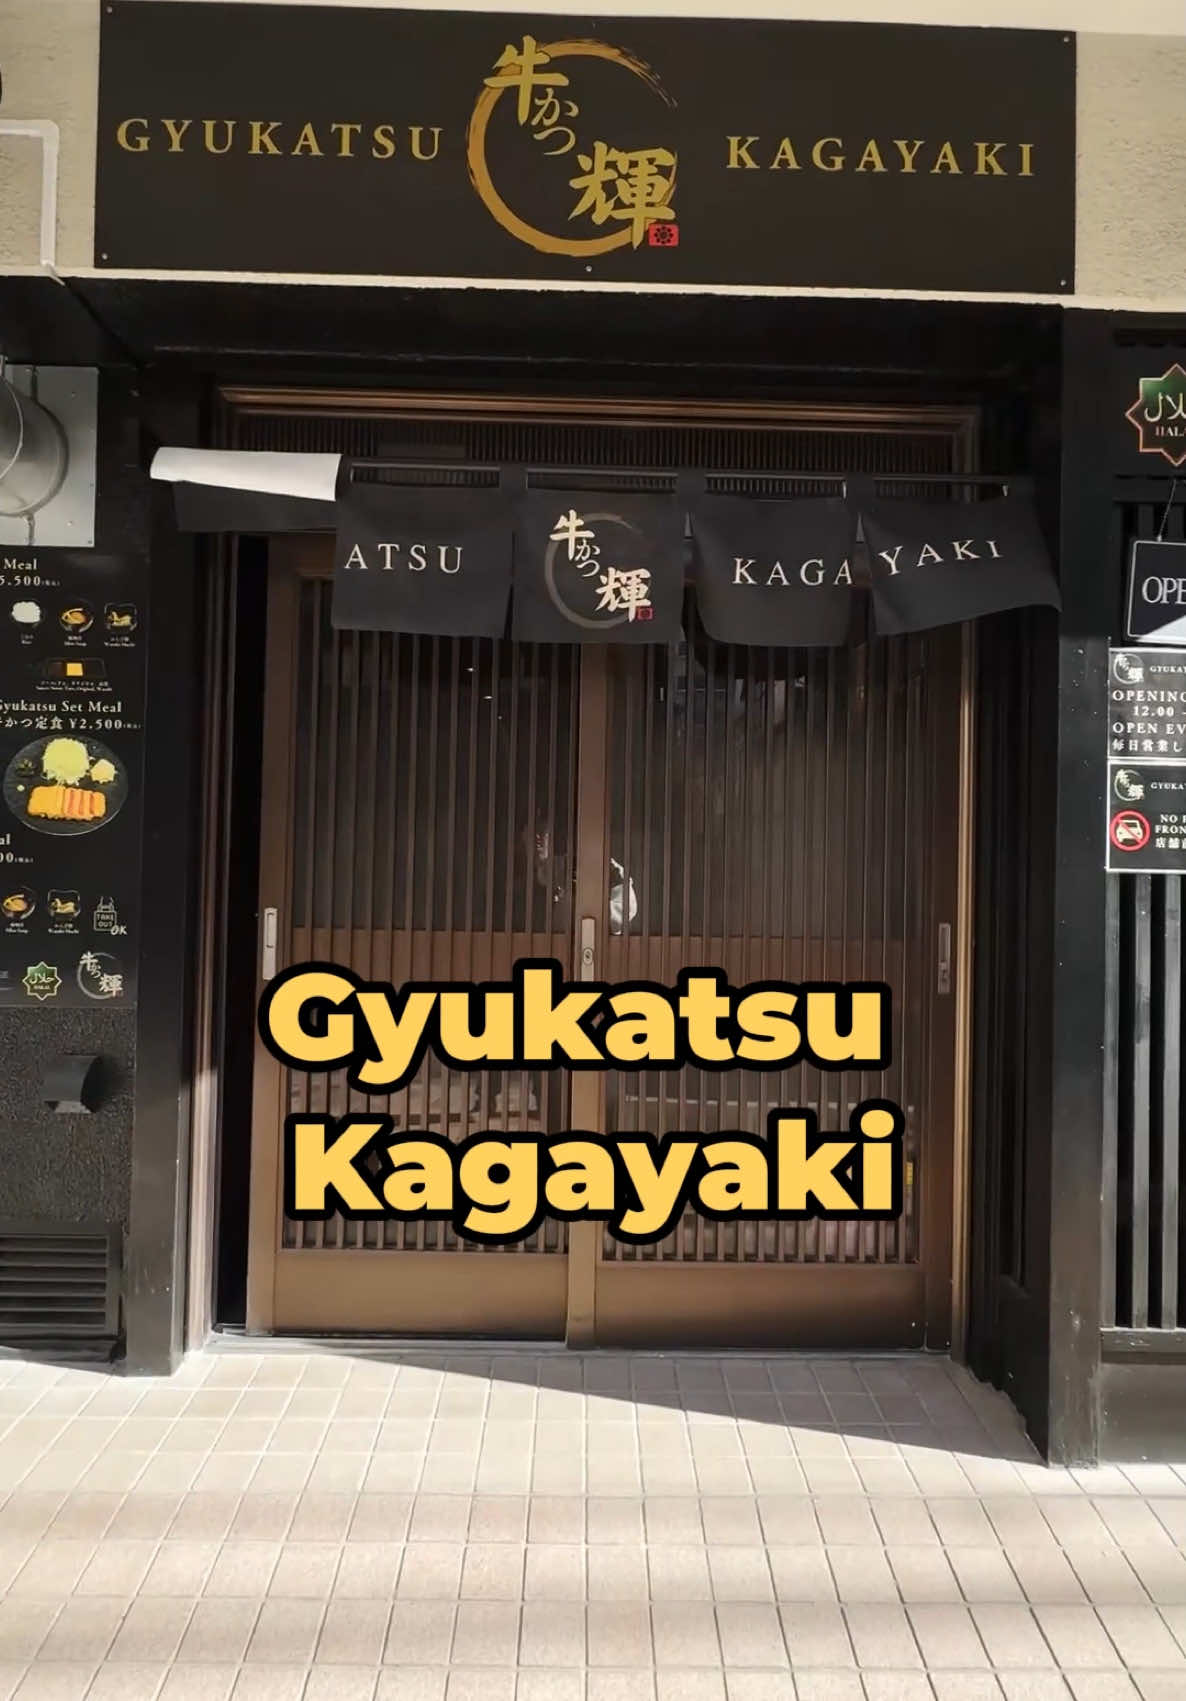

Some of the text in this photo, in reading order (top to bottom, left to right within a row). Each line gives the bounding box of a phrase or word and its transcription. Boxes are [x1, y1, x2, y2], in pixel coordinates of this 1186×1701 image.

[116, 118, 443, 160] GYUKATSU
[726, 135, 1036, 177] KAGAYAKI
[1155, 425, 1186, 437] HAL
[3, 557, 38, 570] Meal
[344, 543, 464, 575] ATSU
[732, 539, 1004, 587] KAGA YAKI
[0, 699, 122, 714] yukatsu Set Meal
[1133, 706, 1175, 717] 12.00
[0, 715, 63, 730] かつ定食
[1112, 722, 1158, 734] OPEN
[1150, 781, 1186, 790] GYUKA
[1160, 813, 1178, 823] NO
